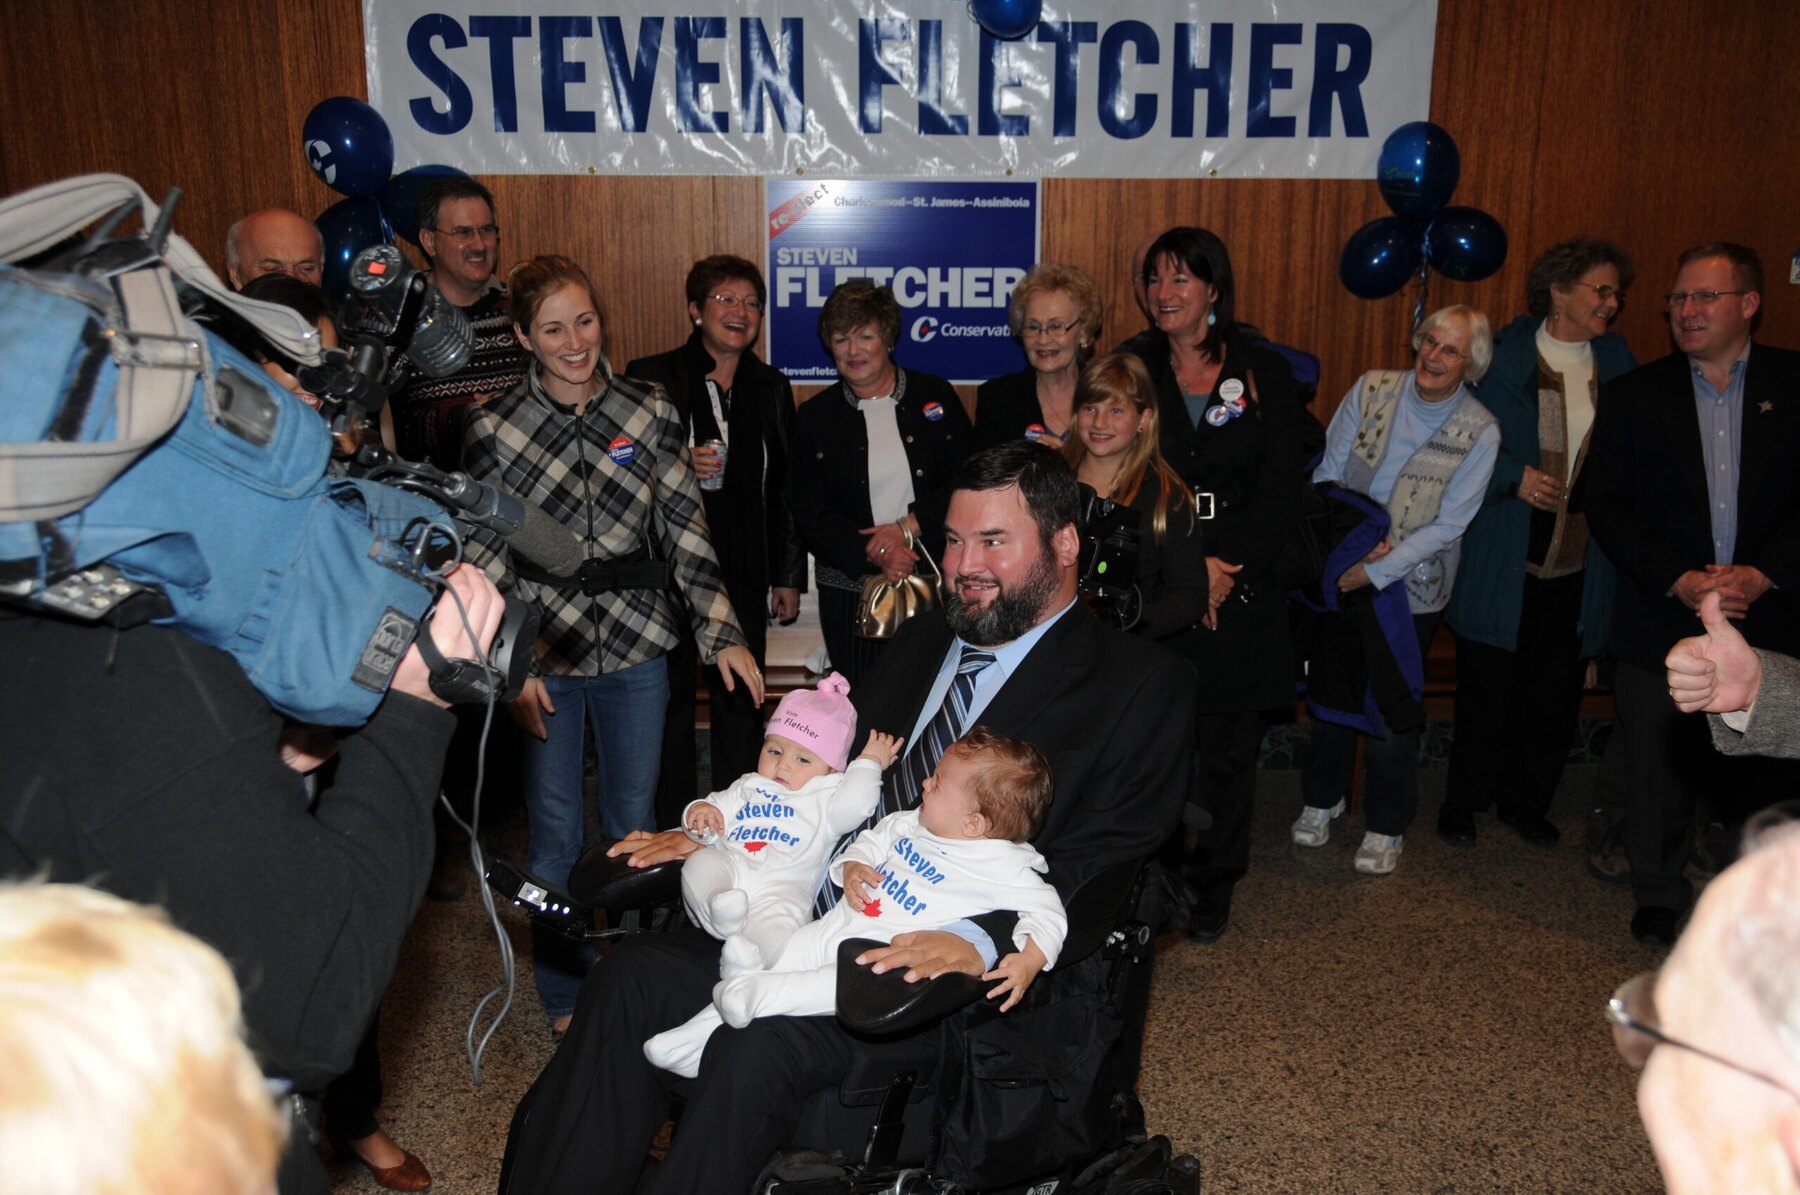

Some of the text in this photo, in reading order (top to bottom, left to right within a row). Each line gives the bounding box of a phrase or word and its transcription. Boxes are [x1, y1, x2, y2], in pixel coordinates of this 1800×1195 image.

[406, 13, 1372, 139] STEVEN FLETCHER
[777, 247, 857, 265] STEVEN
[784, 718, 819, 739] Fletcher
[894, 838, 945, 885] Steven
[875, 860, 927, 916] ltcher
